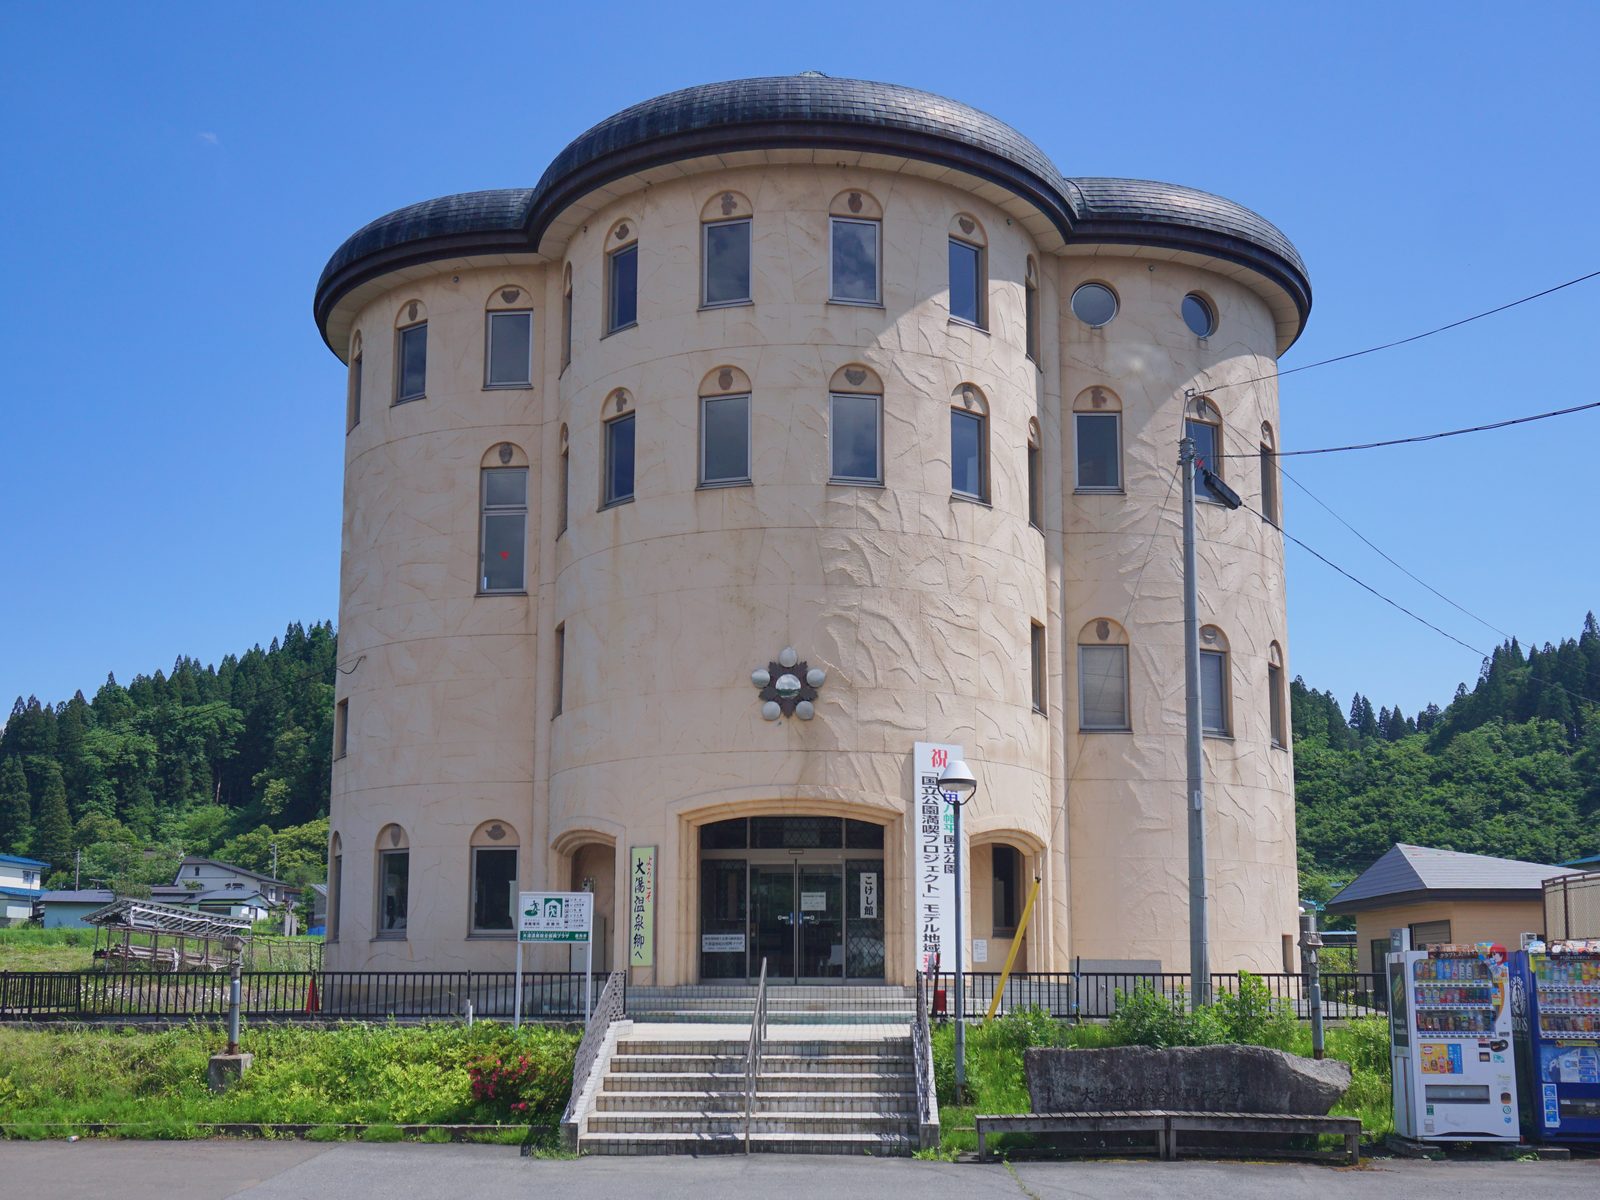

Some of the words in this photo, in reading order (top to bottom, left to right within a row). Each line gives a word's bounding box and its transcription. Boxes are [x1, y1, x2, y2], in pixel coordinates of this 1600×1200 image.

[931, 749, 948, 769] 祝
[864, 876, 874, 916] こけし館
